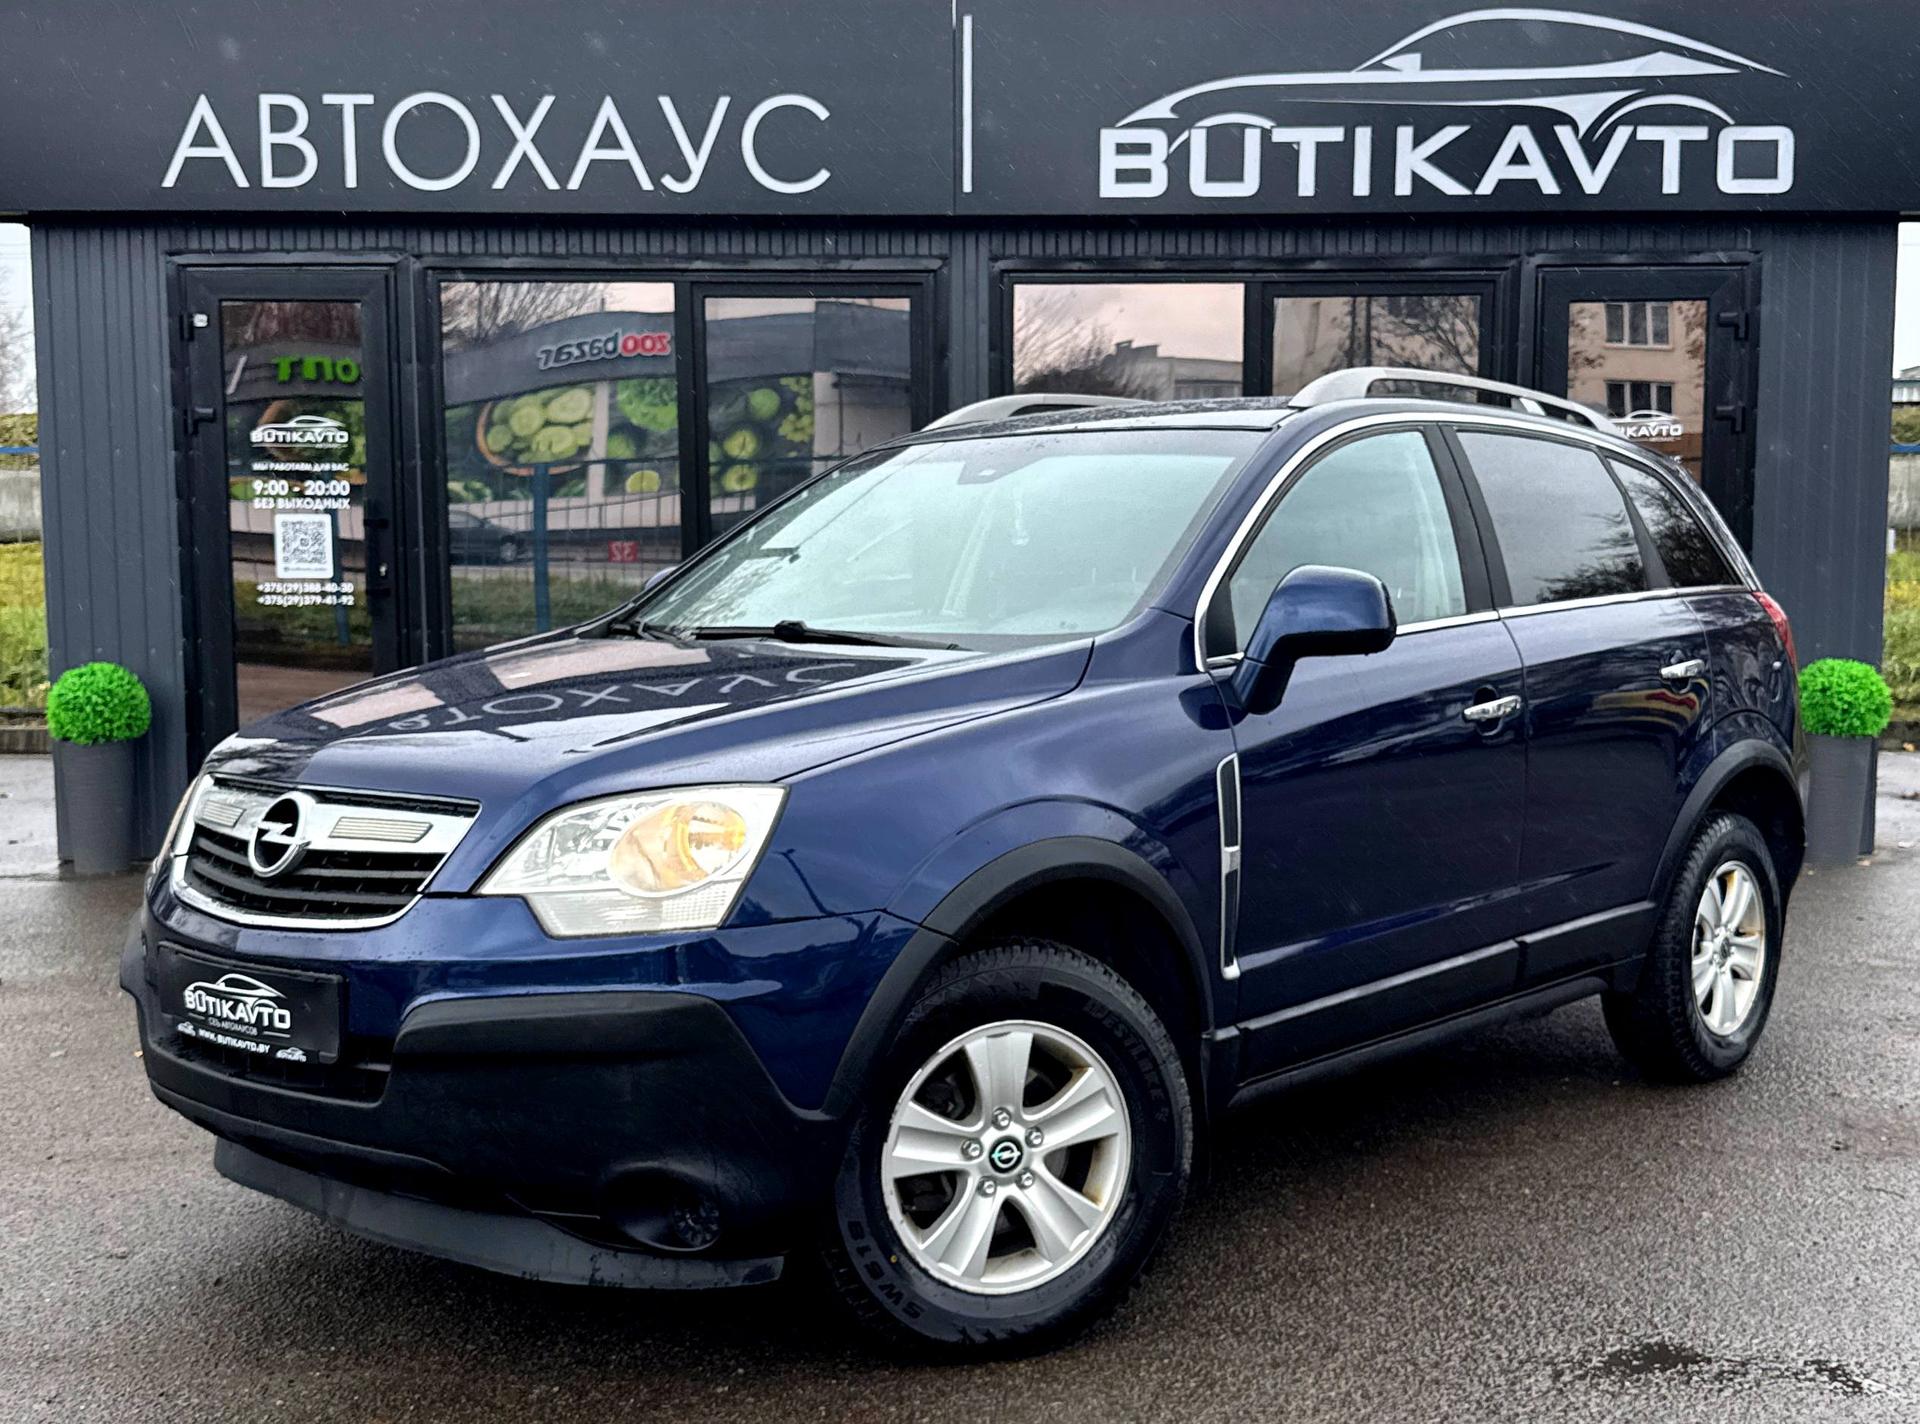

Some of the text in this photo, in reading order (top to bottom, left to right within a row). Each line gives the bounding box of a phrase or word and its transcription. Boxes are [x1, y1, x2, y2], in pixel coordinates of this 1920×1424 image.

[161, 92, 831, 194] АВТОХАУС
[1098, 124, 1794, 198] BUTIKAVTO
[249, 430, 349, 443] BUTIKAVTO
[253, 480, 289, 496] 9:00
[304, 480, 350, 496] 20:00
[254, 498, 350, 511] БЕЗ ВЫХОДНЫХ
[184, 989, 291, 1029] BUTIKAVTO
